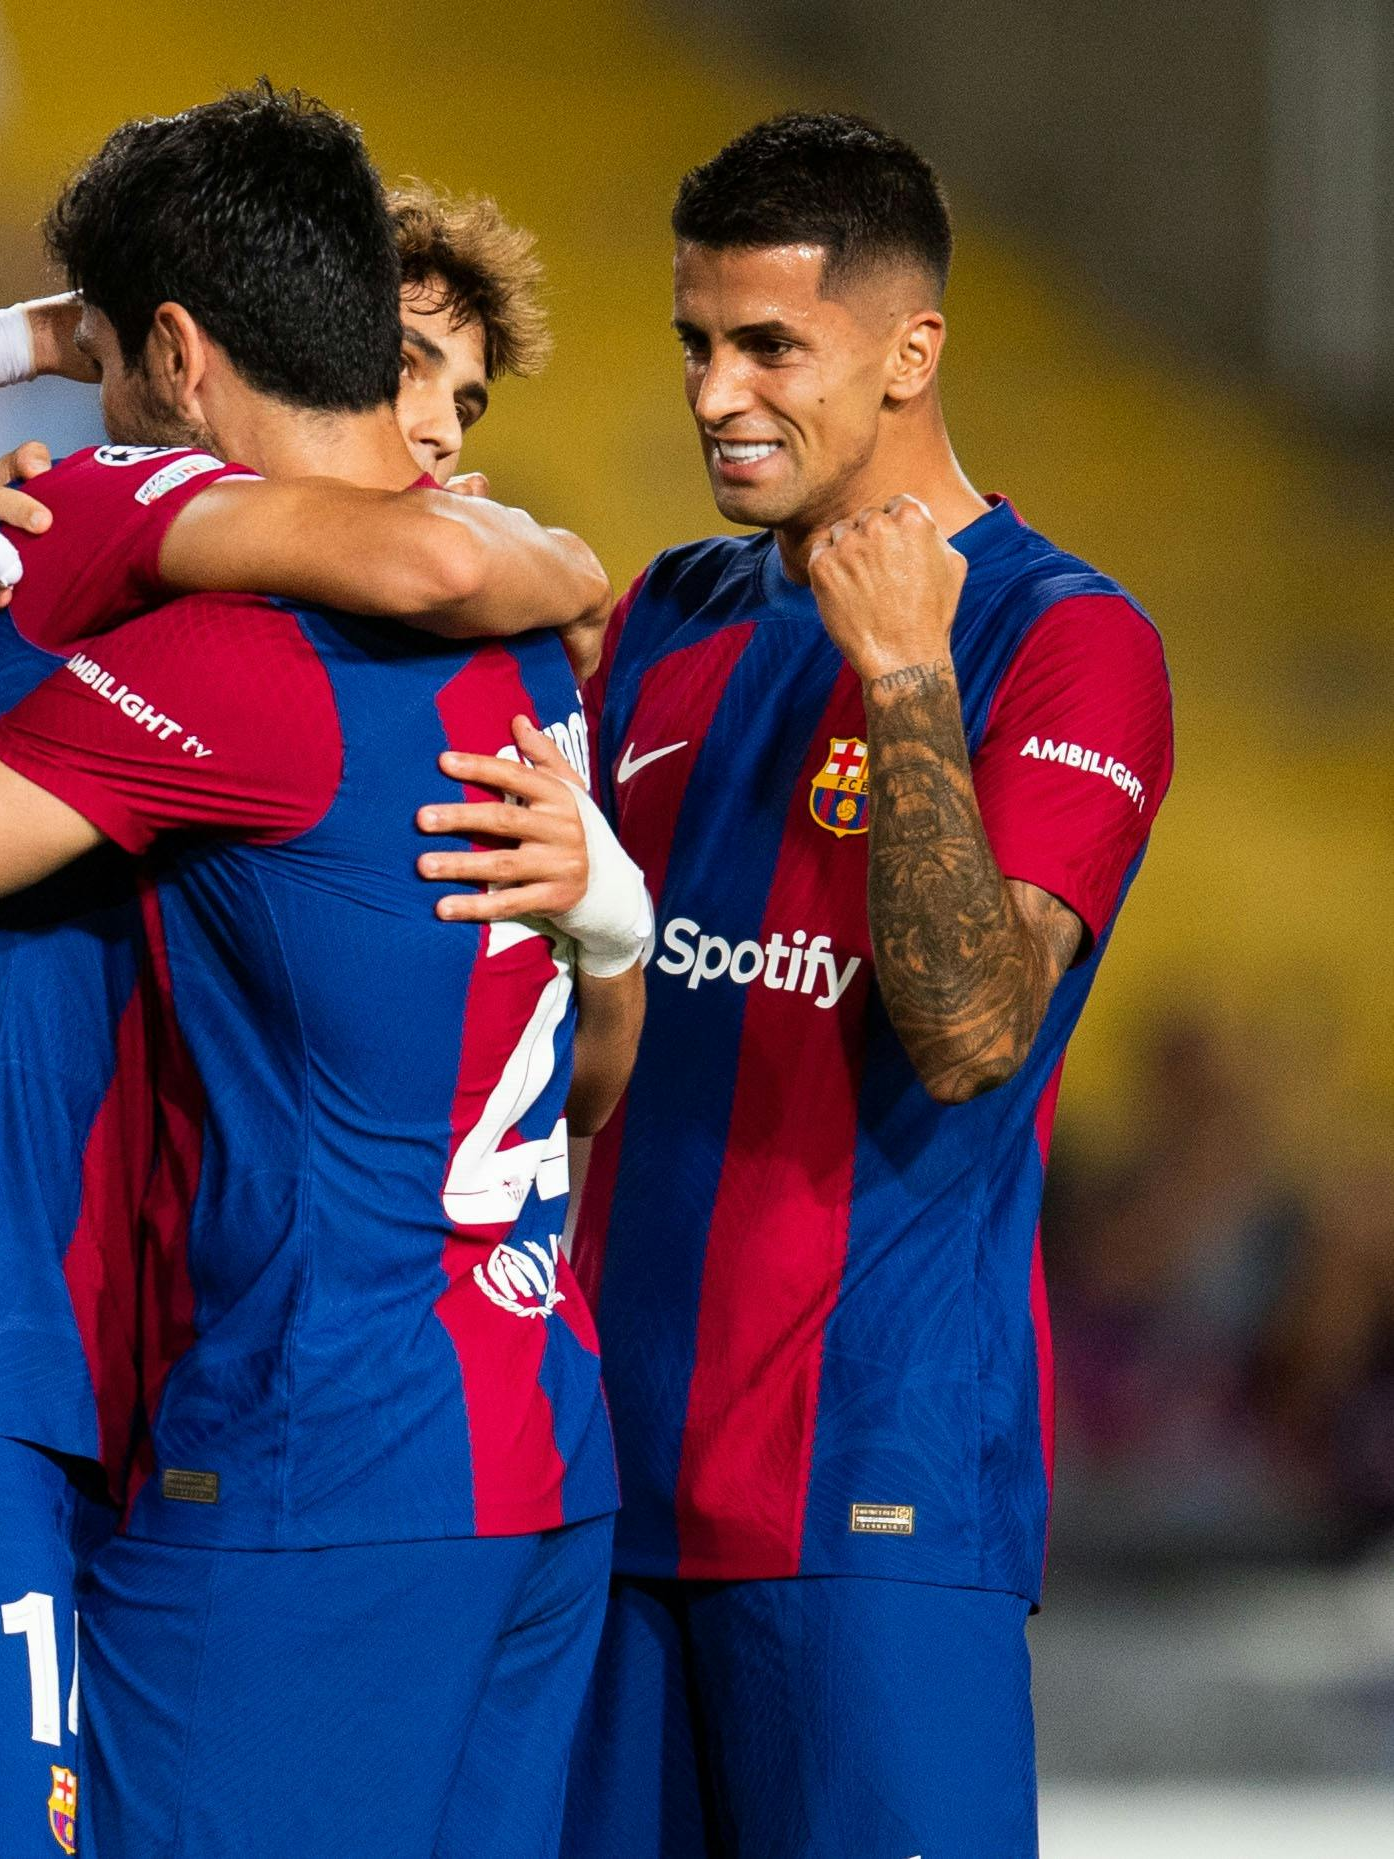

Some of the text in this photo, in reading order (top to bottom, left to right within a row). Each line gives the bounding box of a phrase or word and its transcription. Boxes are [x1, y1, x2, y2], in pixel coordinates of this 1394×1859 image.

[182, 735, 213, 758] tv
[1019, 735, 1143, 803] AMBILIGHT
[656, 917, 861, 1009] Spotify
[443, 910, 570, 1225] 2
[1, 1591, 79, 1747] 1
